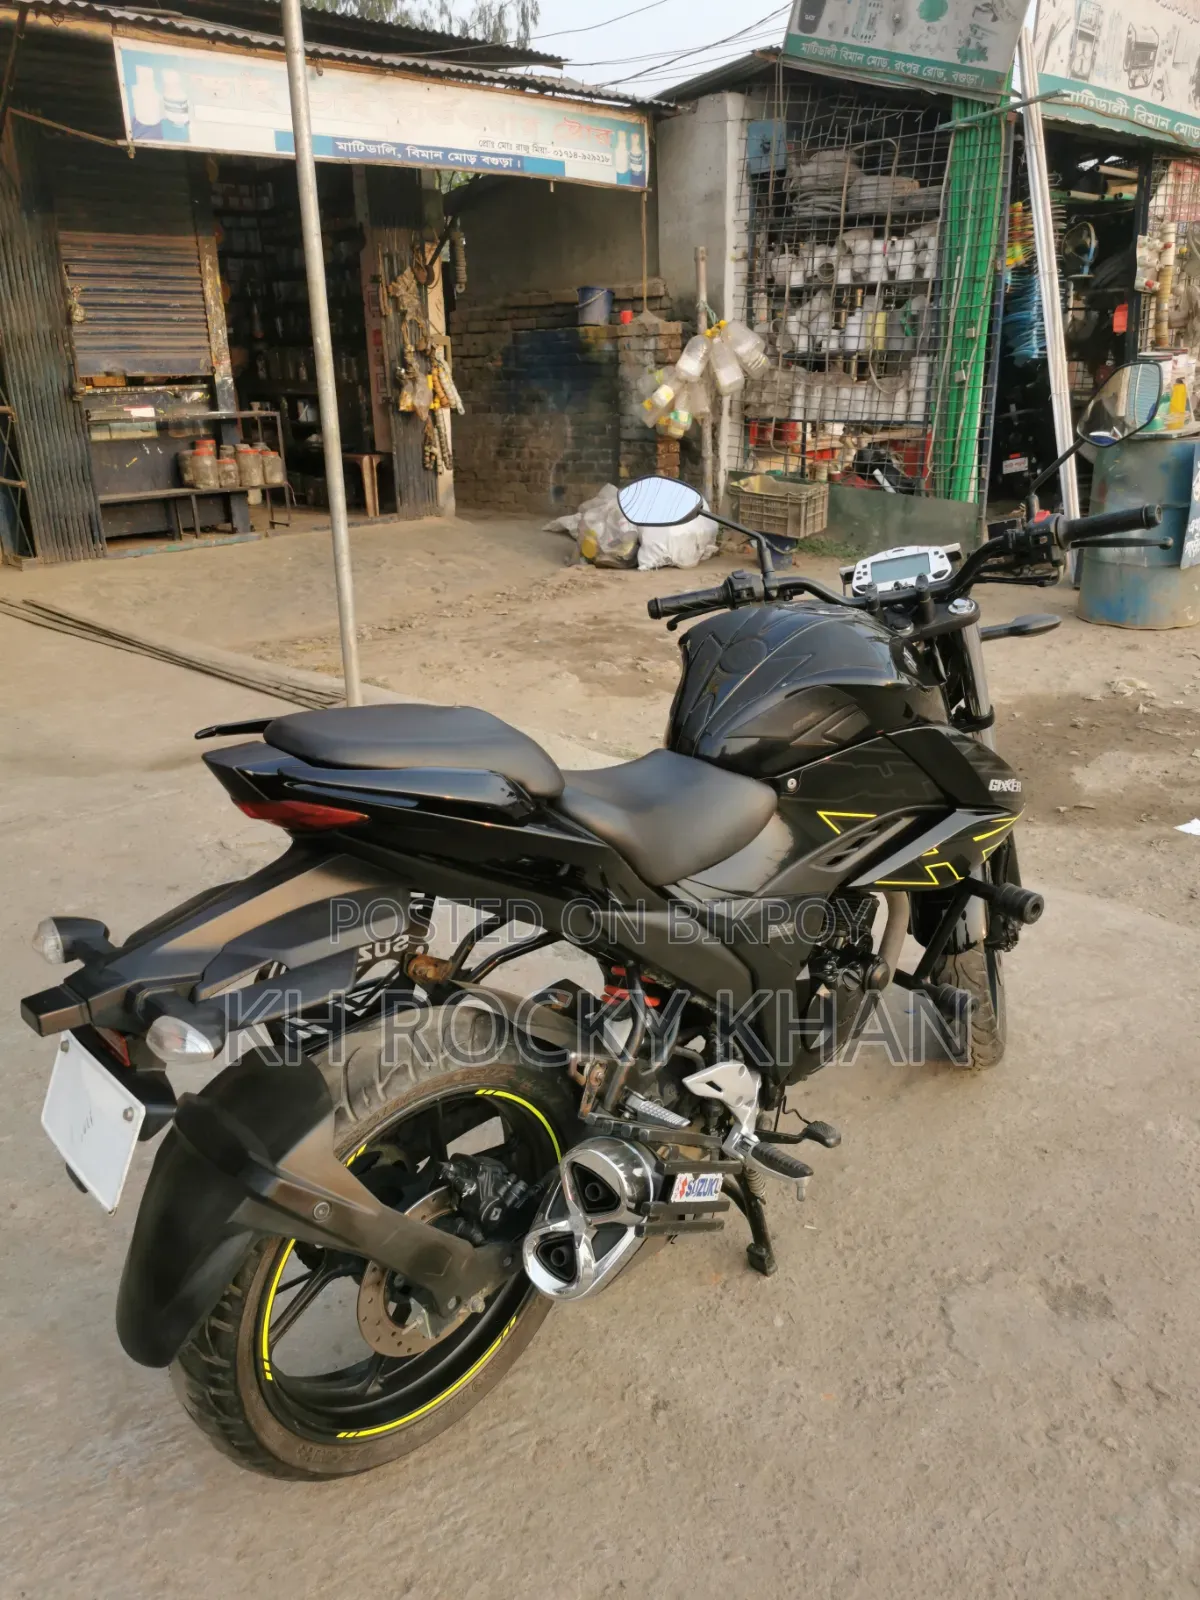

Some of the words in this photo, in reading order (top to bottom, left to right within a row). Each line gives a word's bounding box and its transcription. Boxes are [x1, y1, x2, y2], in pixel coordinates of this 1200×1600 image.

[840, 46, 865, 64] বিমান
[895, 60, 920, 75] রংপুর
[1133, 104, 1172, 130] বিমান
[405, 145, 443, 161] বিমান
[447, 153, 477, 165] মোড়
[685, 1178, 719, 1197] SUZUKI
